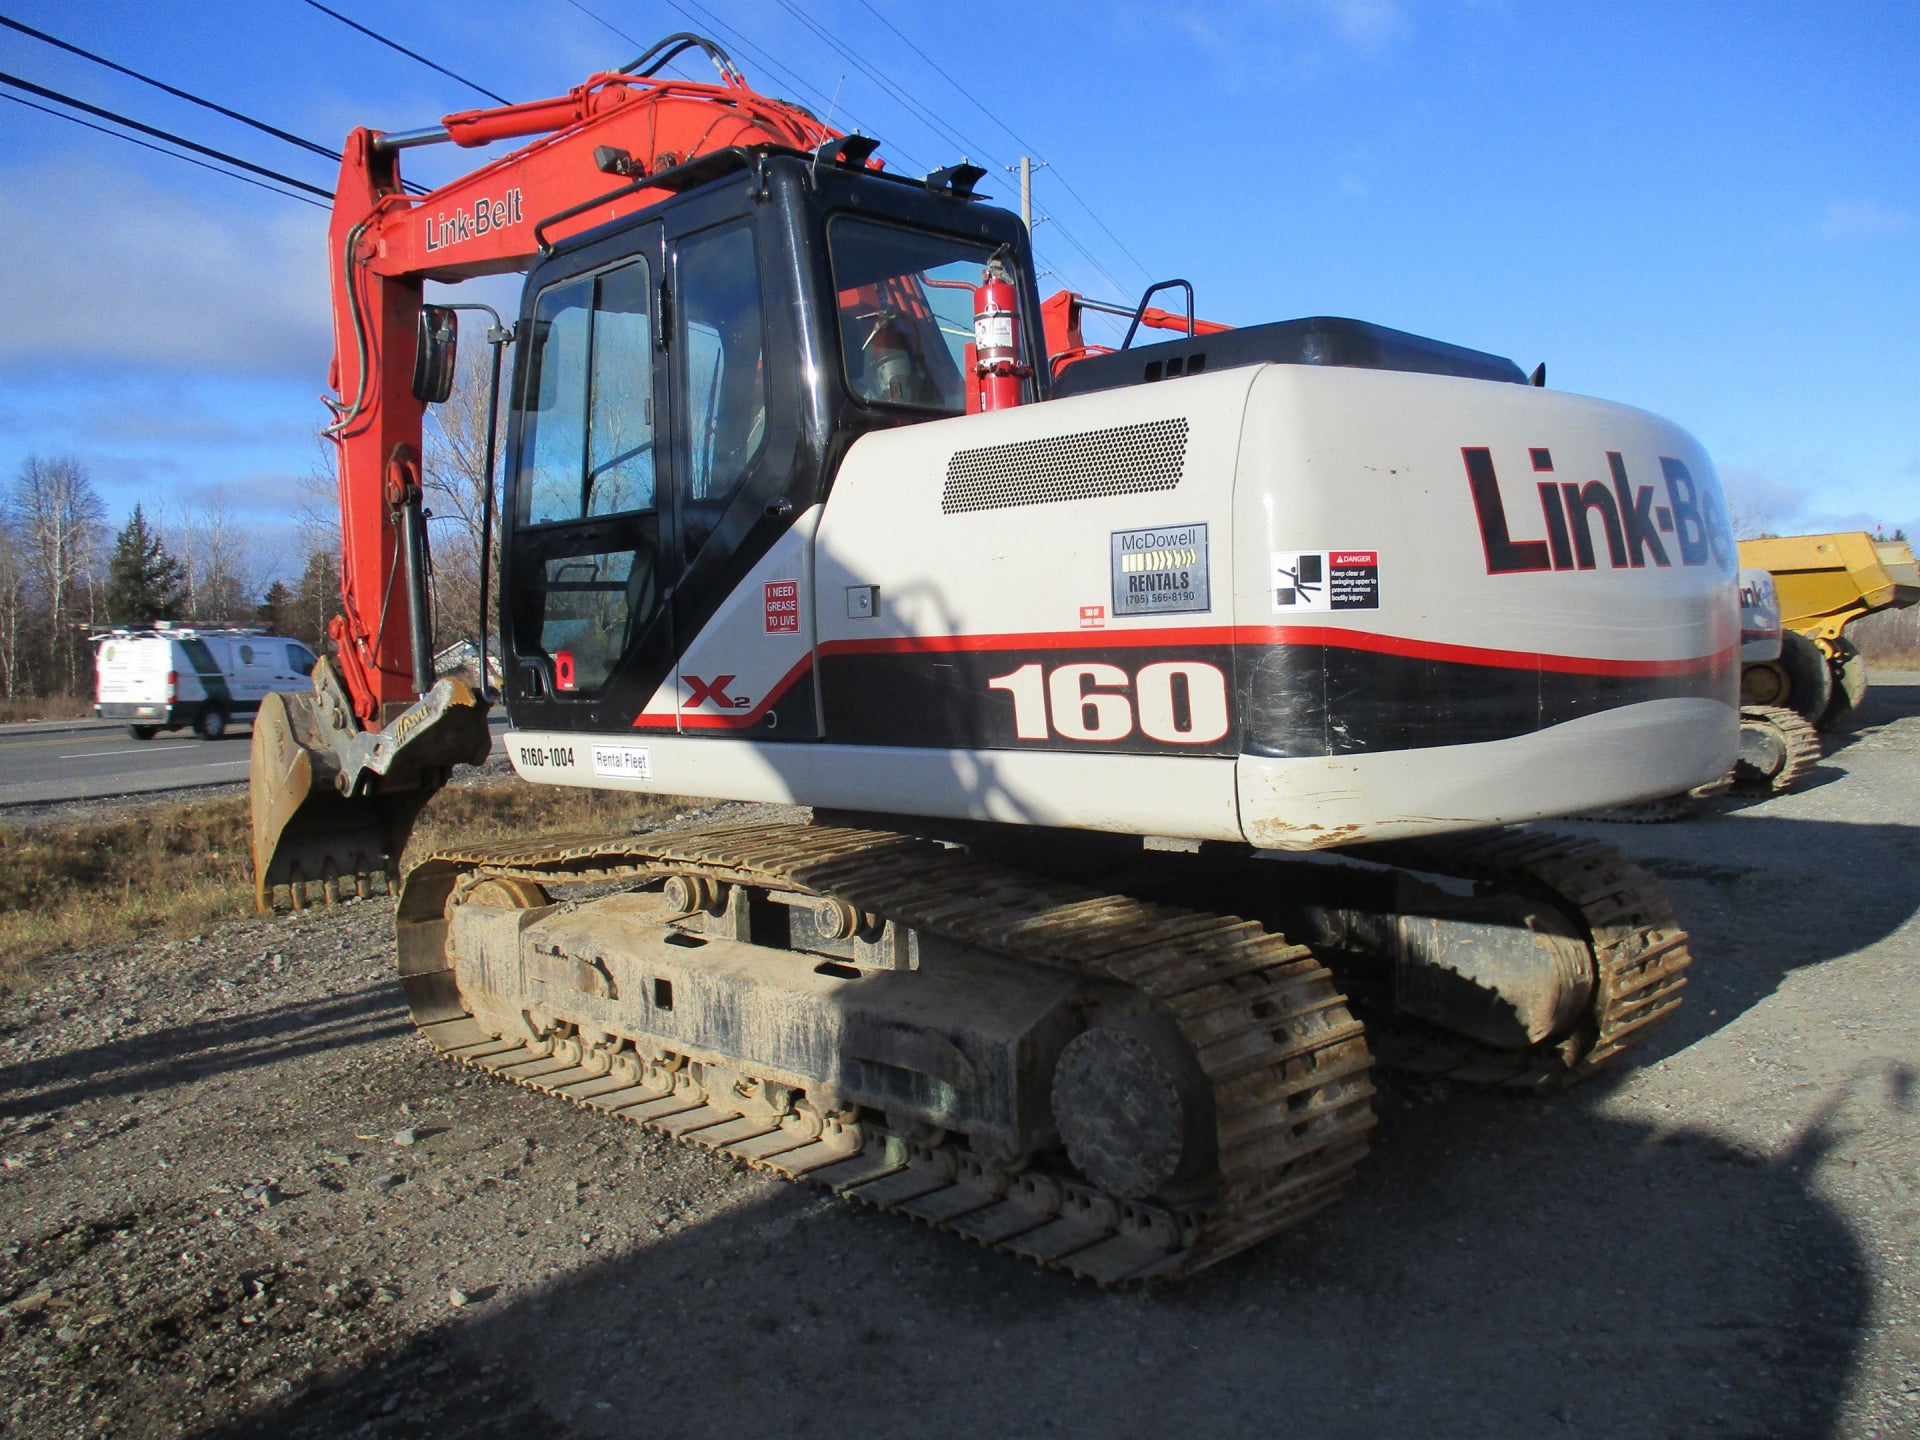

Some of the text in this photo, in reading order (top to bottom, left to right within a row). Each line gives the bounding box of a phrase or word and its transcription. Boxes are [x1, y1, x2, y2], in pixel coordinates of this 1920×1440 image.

[426, 188, 522, 253] Link-Belt
[1122, 529, 1196, 551] McDowell
[1343, 555, 1371, 563] DANGER
[1331, 570, 1345, 578] Keep
[1129, 572, 1189, 593] RENTALS
[767, 586, 794, 598] I NEED
[1125, 591, 1195, 606] (705) 566-8190
[767, 600, 796, 612] GREASE
[768, 615, 796, 627] TO LIVE
[988, 661, 1231, 745] 160
[520, 746, 575, 767] R160-1004
[596, 751, 646, 769] Rental Fleet
